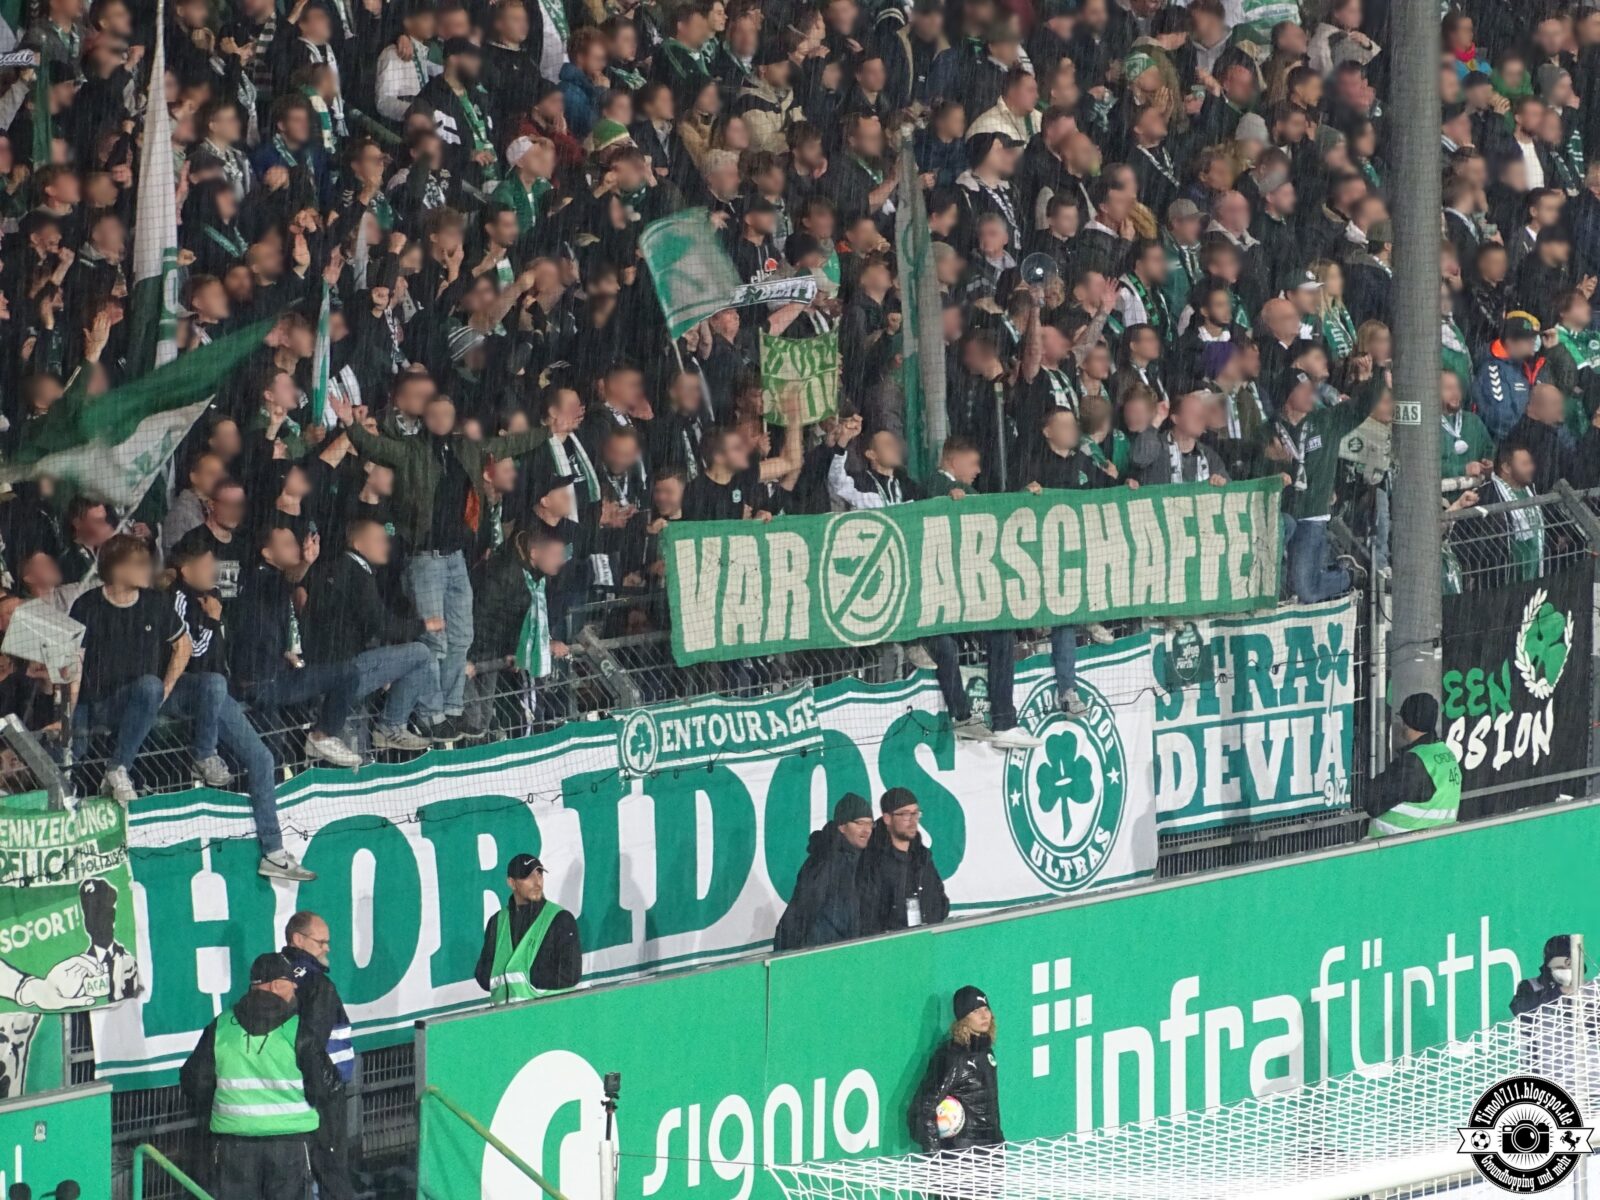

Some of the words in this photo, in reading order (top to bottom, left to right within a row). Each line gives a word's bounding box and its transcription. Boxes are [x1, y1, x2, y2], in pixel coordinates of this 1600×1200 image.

[675, 532, 810, 652] VAR
[917, 491, 1280, 627] ABSCHAFFEN
[660, 695, 818, 753] ENTOURAGE
[1156, 711, 1344, 812] DEVIA
[130, 710, 966, 1038] HORIDOS
[1030, 826, 1112, 882] ULTRAS
[0, 904, 80, 953] SOFORT!
[643, 1068, 880, 1200] signia
